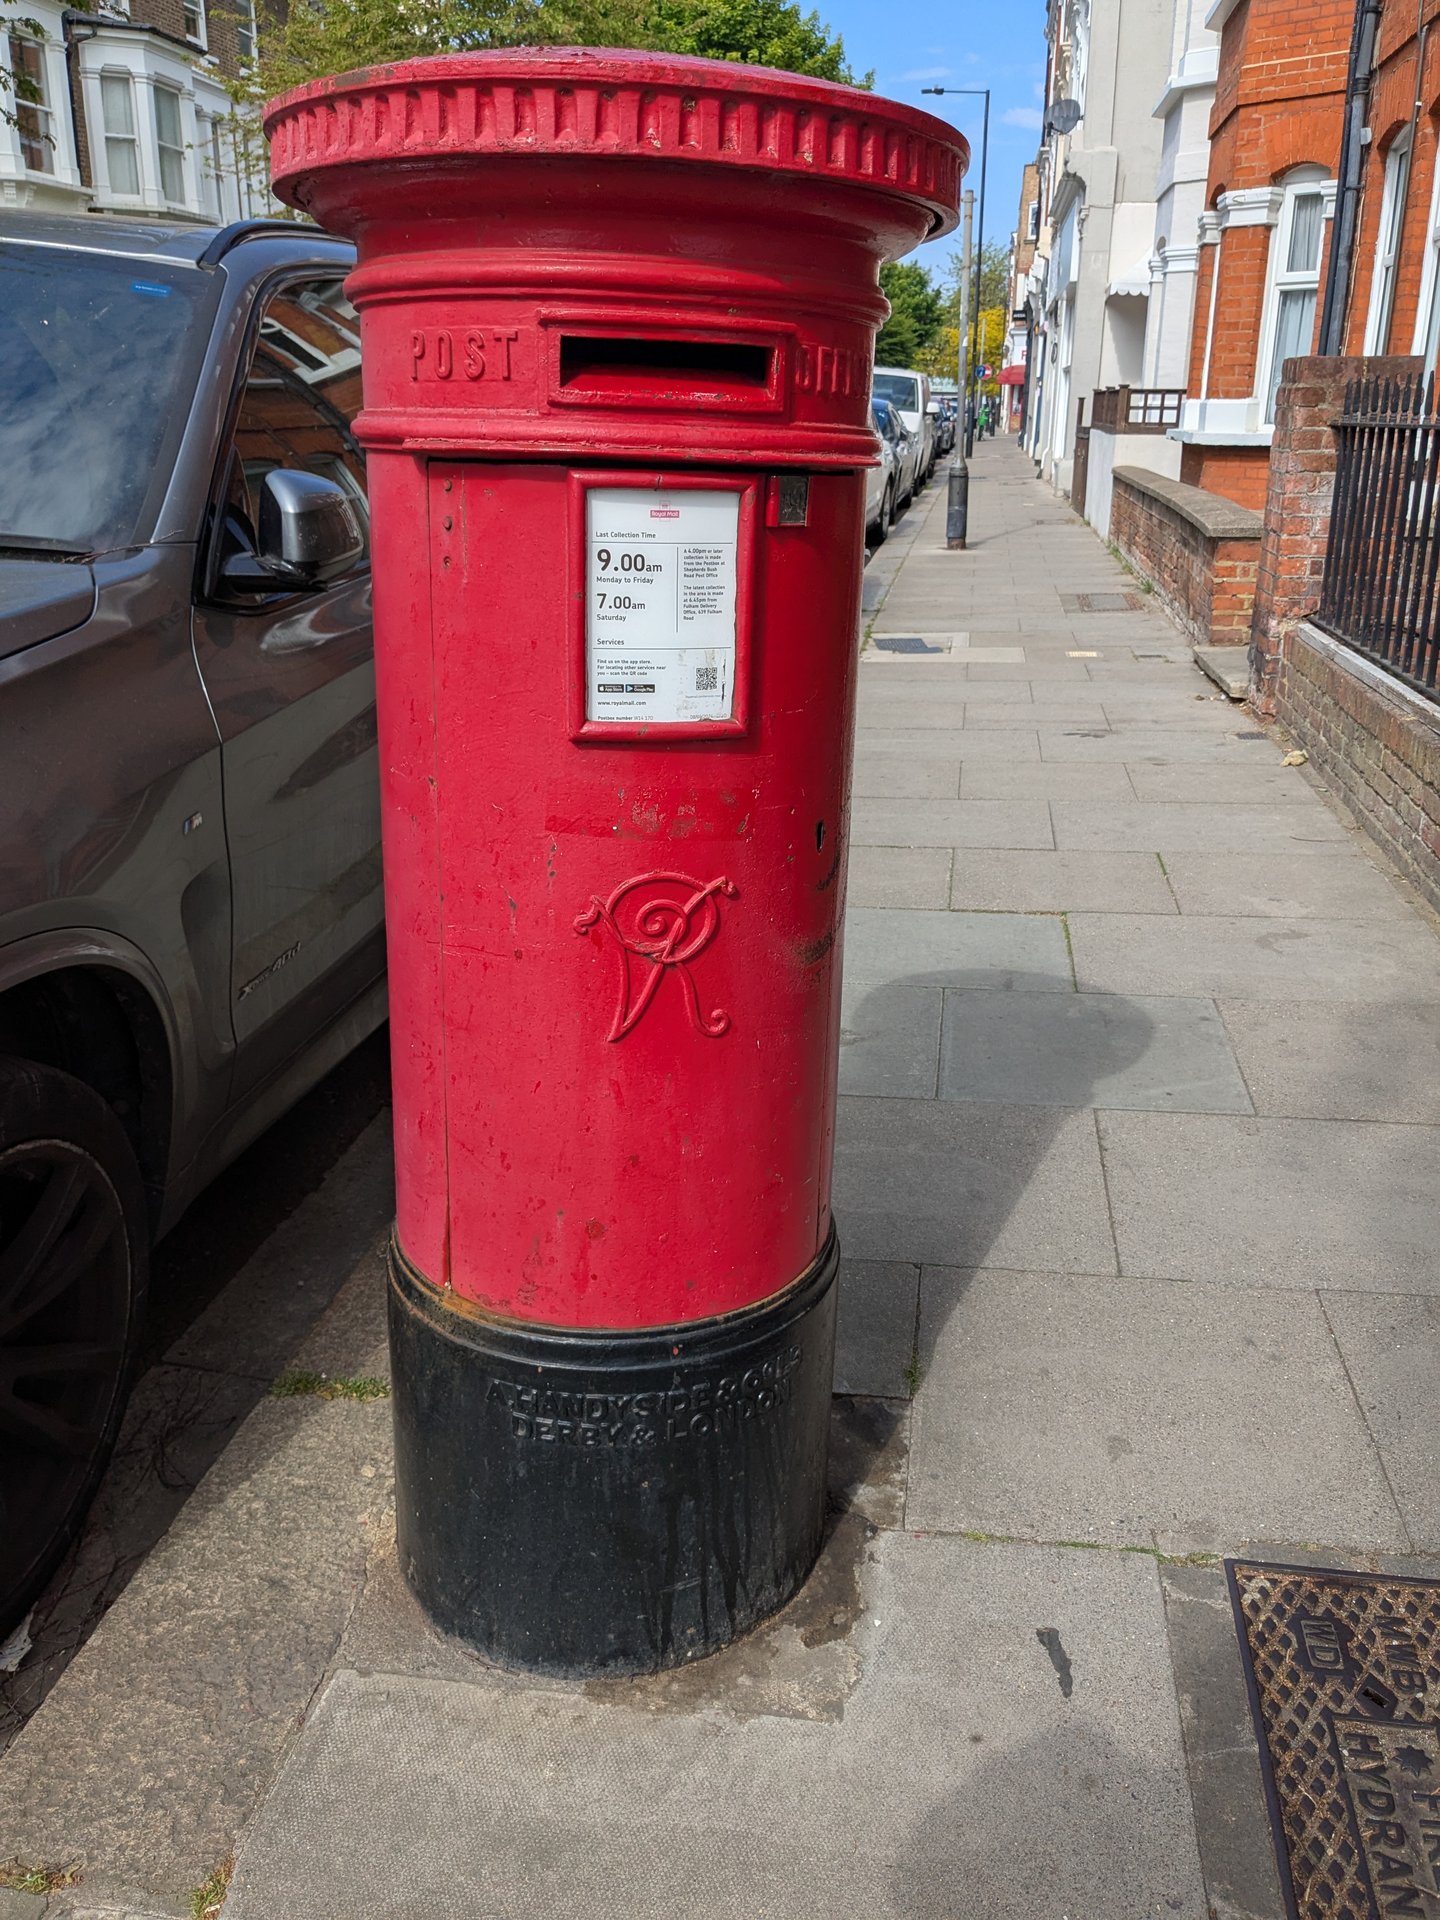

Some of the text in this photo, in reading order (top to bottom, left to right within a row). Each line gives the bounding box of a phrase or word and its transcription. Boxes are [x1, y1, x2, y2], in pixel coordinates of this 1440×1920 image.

[410, 329, 519, 382] POST
[597, 549, 662, 572] 9.00am
[597, 593, 646, 609] 7.00am
[511, 1410, 622, 1447] DERBY
[666, 1378, 791, 1442] LONDON
[1343, 1733, 1427, 1920] HYDRAN
